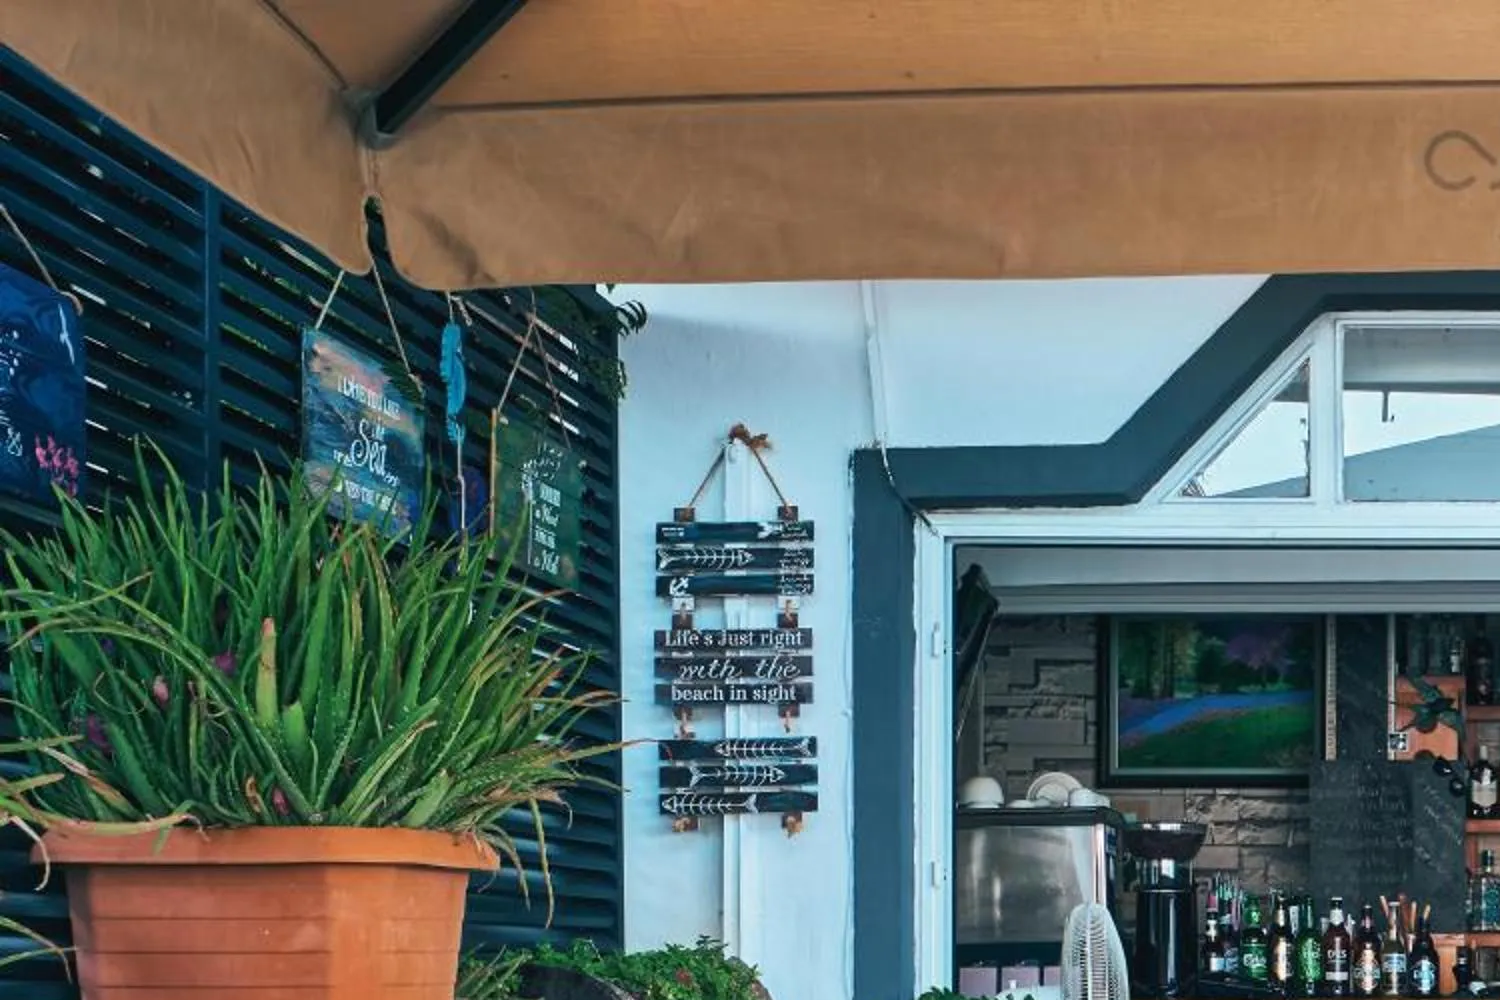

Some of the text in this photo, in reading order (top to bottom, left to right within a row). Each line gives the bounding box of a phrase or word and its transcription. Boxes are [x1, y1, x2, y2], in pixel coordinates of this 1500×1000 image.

[761, 630, 804, 648] right
[678, 653, 802, 682] with the
[671, 685, 797, 704] beach in sight
